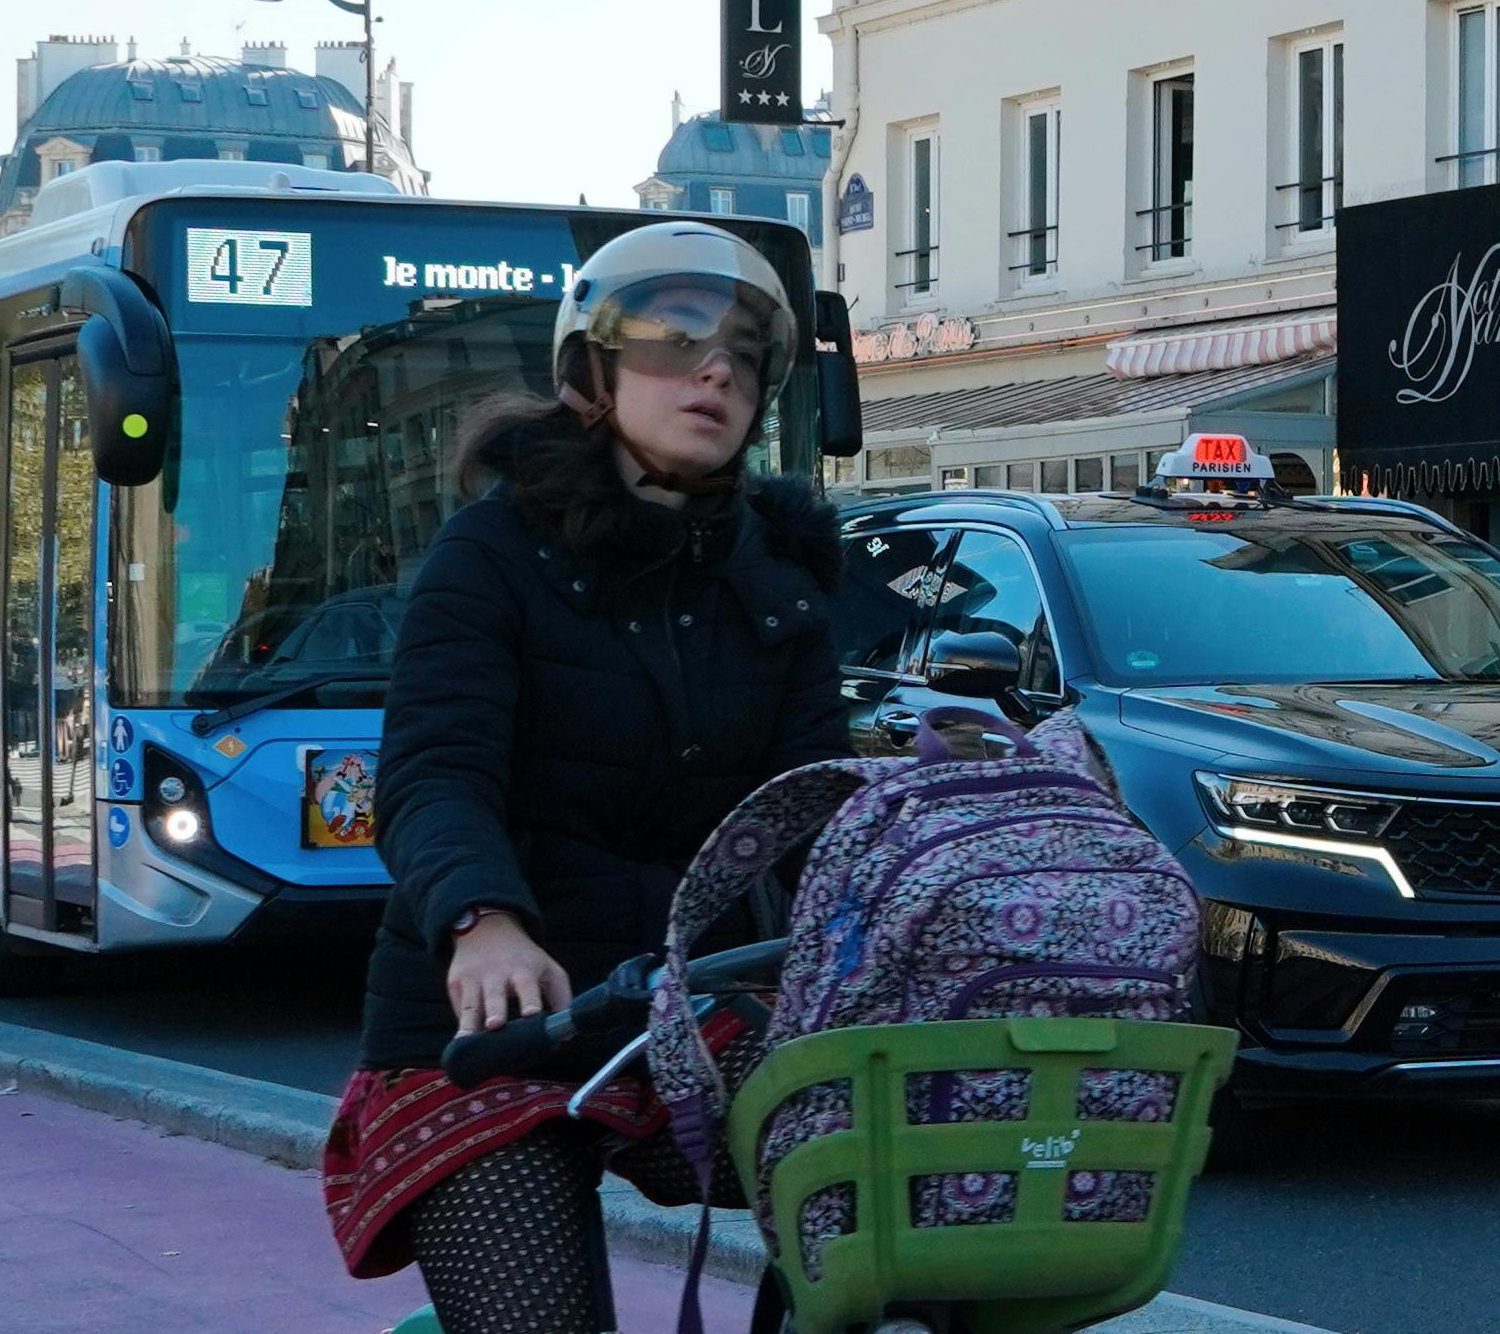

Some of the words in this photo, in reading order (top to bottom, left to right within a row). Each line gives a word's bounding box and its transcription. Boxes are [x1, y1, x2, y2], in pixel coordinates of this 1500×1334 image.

[210, 238, 290, 296] 47
[383, 255, 417, 288] Je
[425, 260, 535, 292] monte
[1192, 462, 1252, 473] PARISIEN
